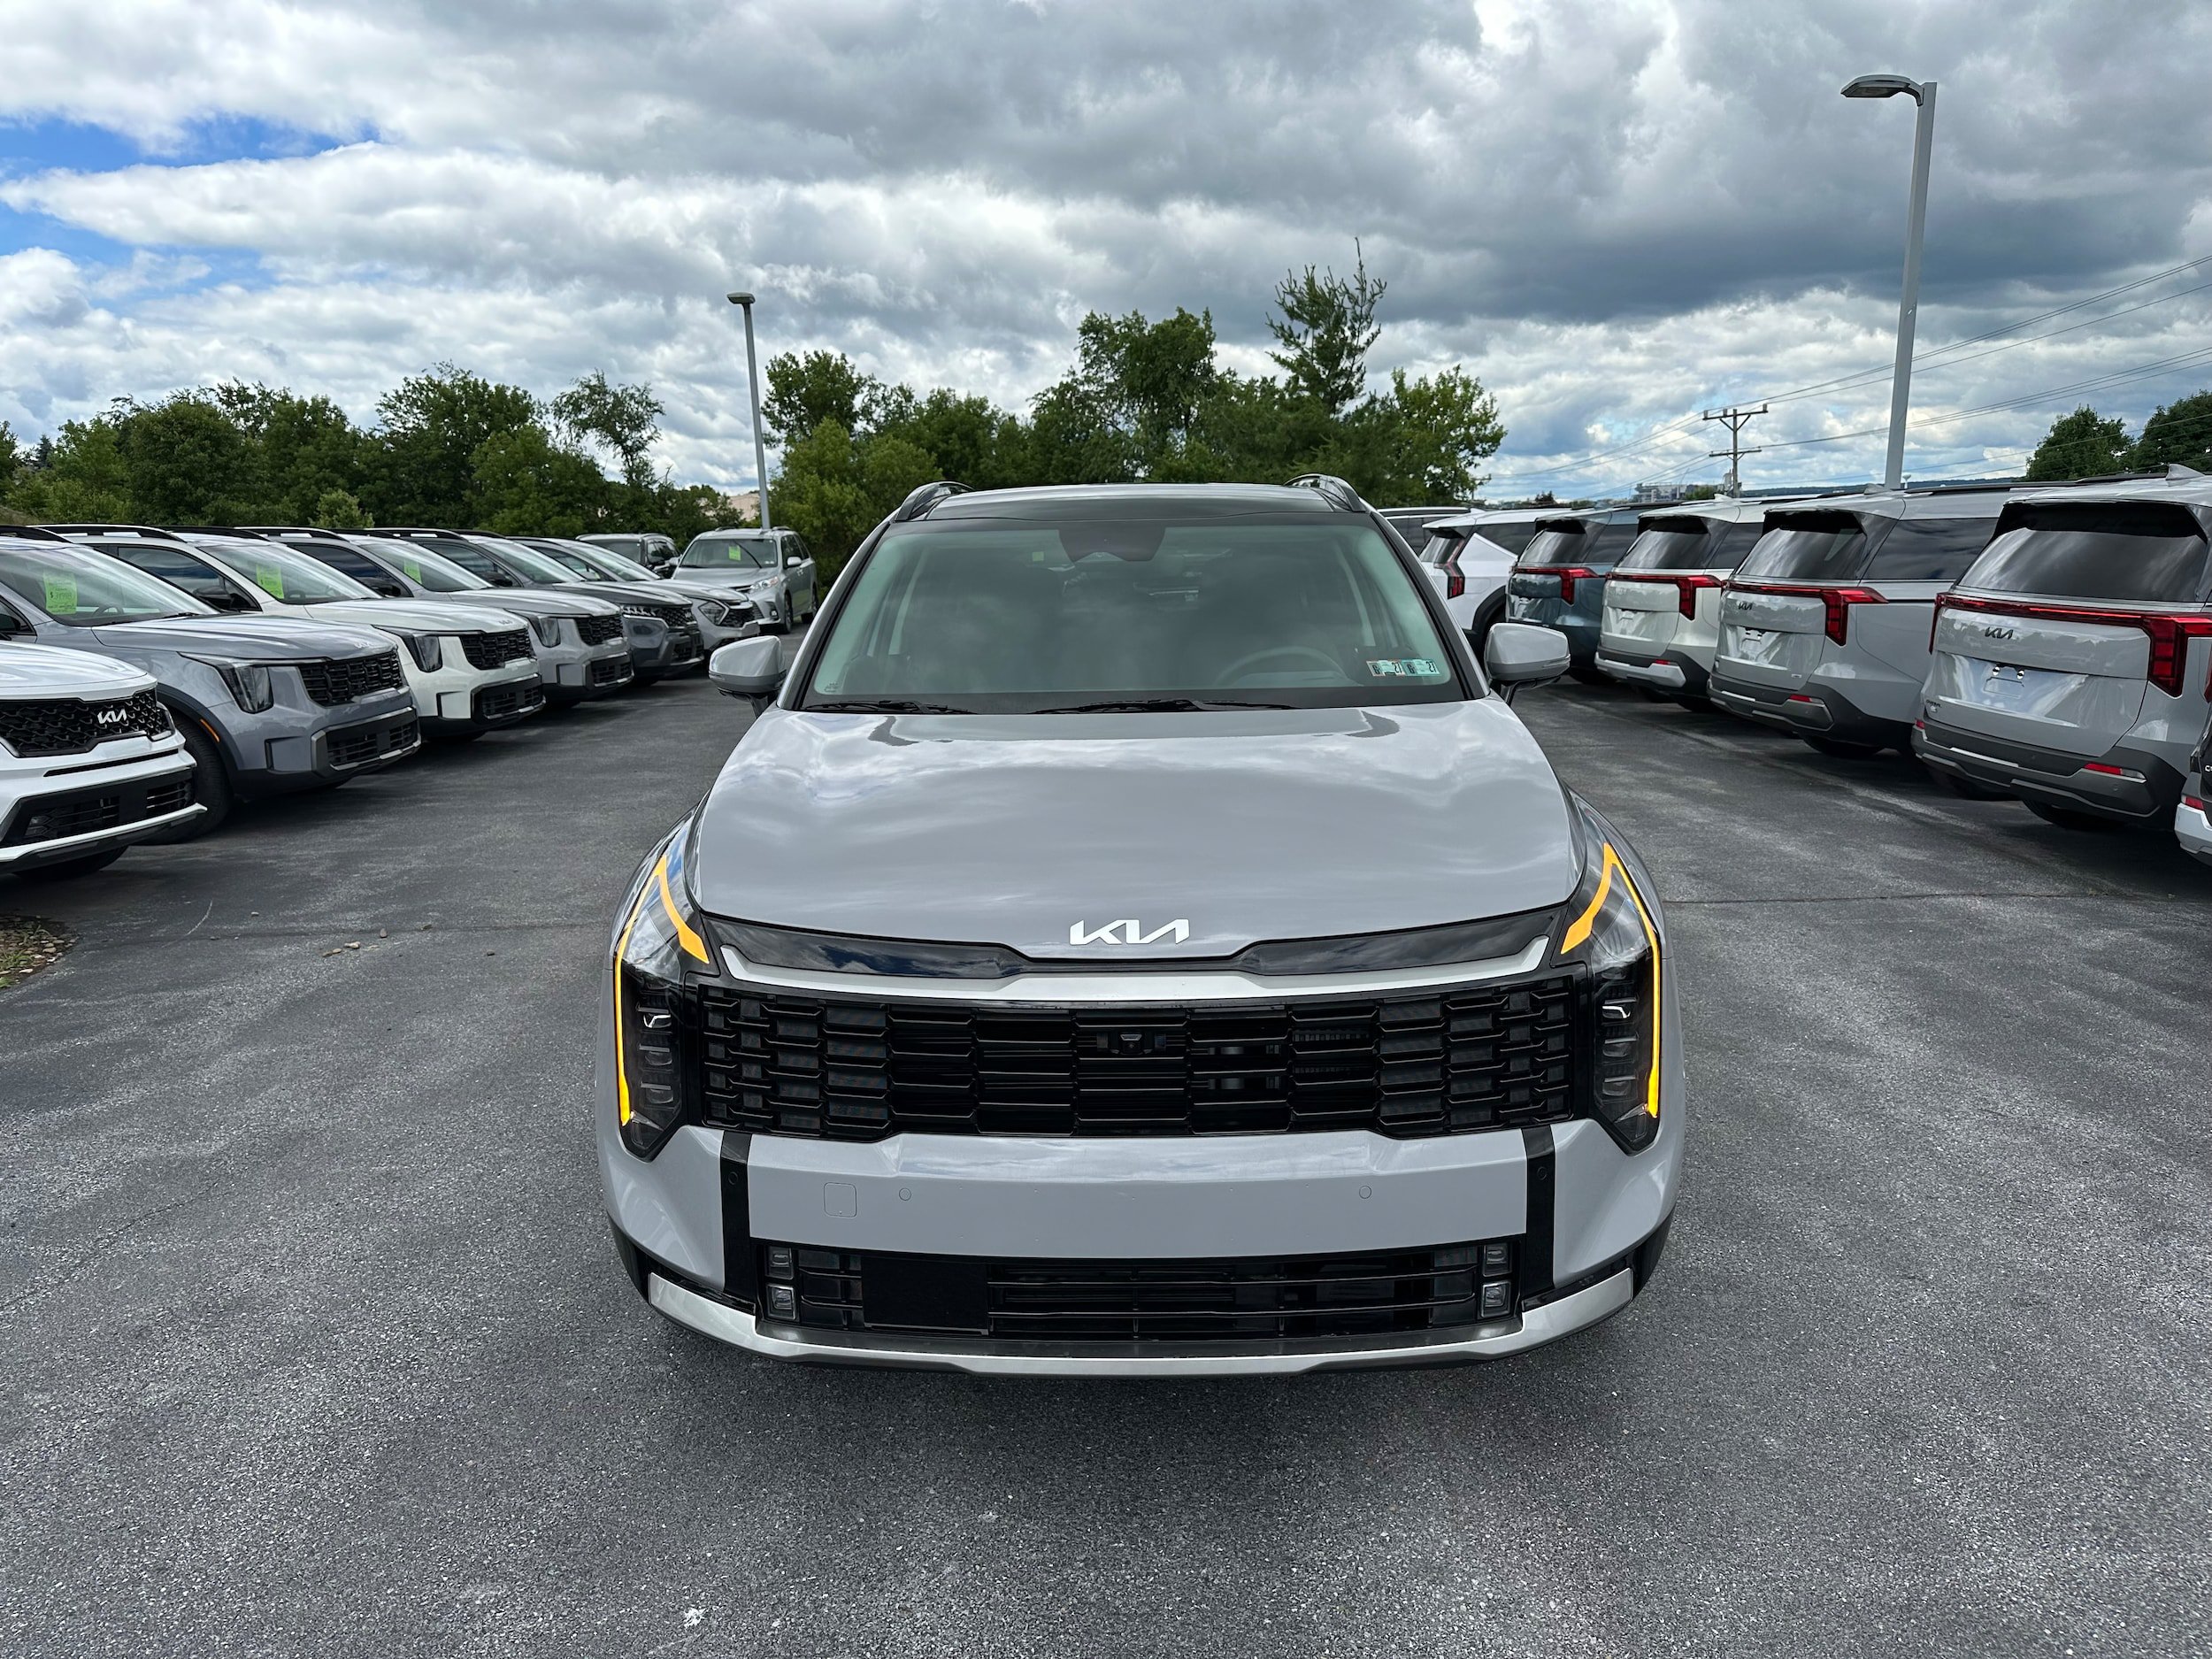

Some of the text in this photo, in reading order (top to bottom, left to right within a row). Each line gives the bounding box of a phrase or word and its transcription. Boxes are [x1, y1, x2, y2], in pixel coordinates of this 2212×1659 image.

[1985, 626, 2014, 640] KIA
[1392, 662, 1402, 673] 27
[1425, 661, 1437, 672] 27
[97, 709, 127, 725] KIA
[1070, 918, 1190, 945] KIA
